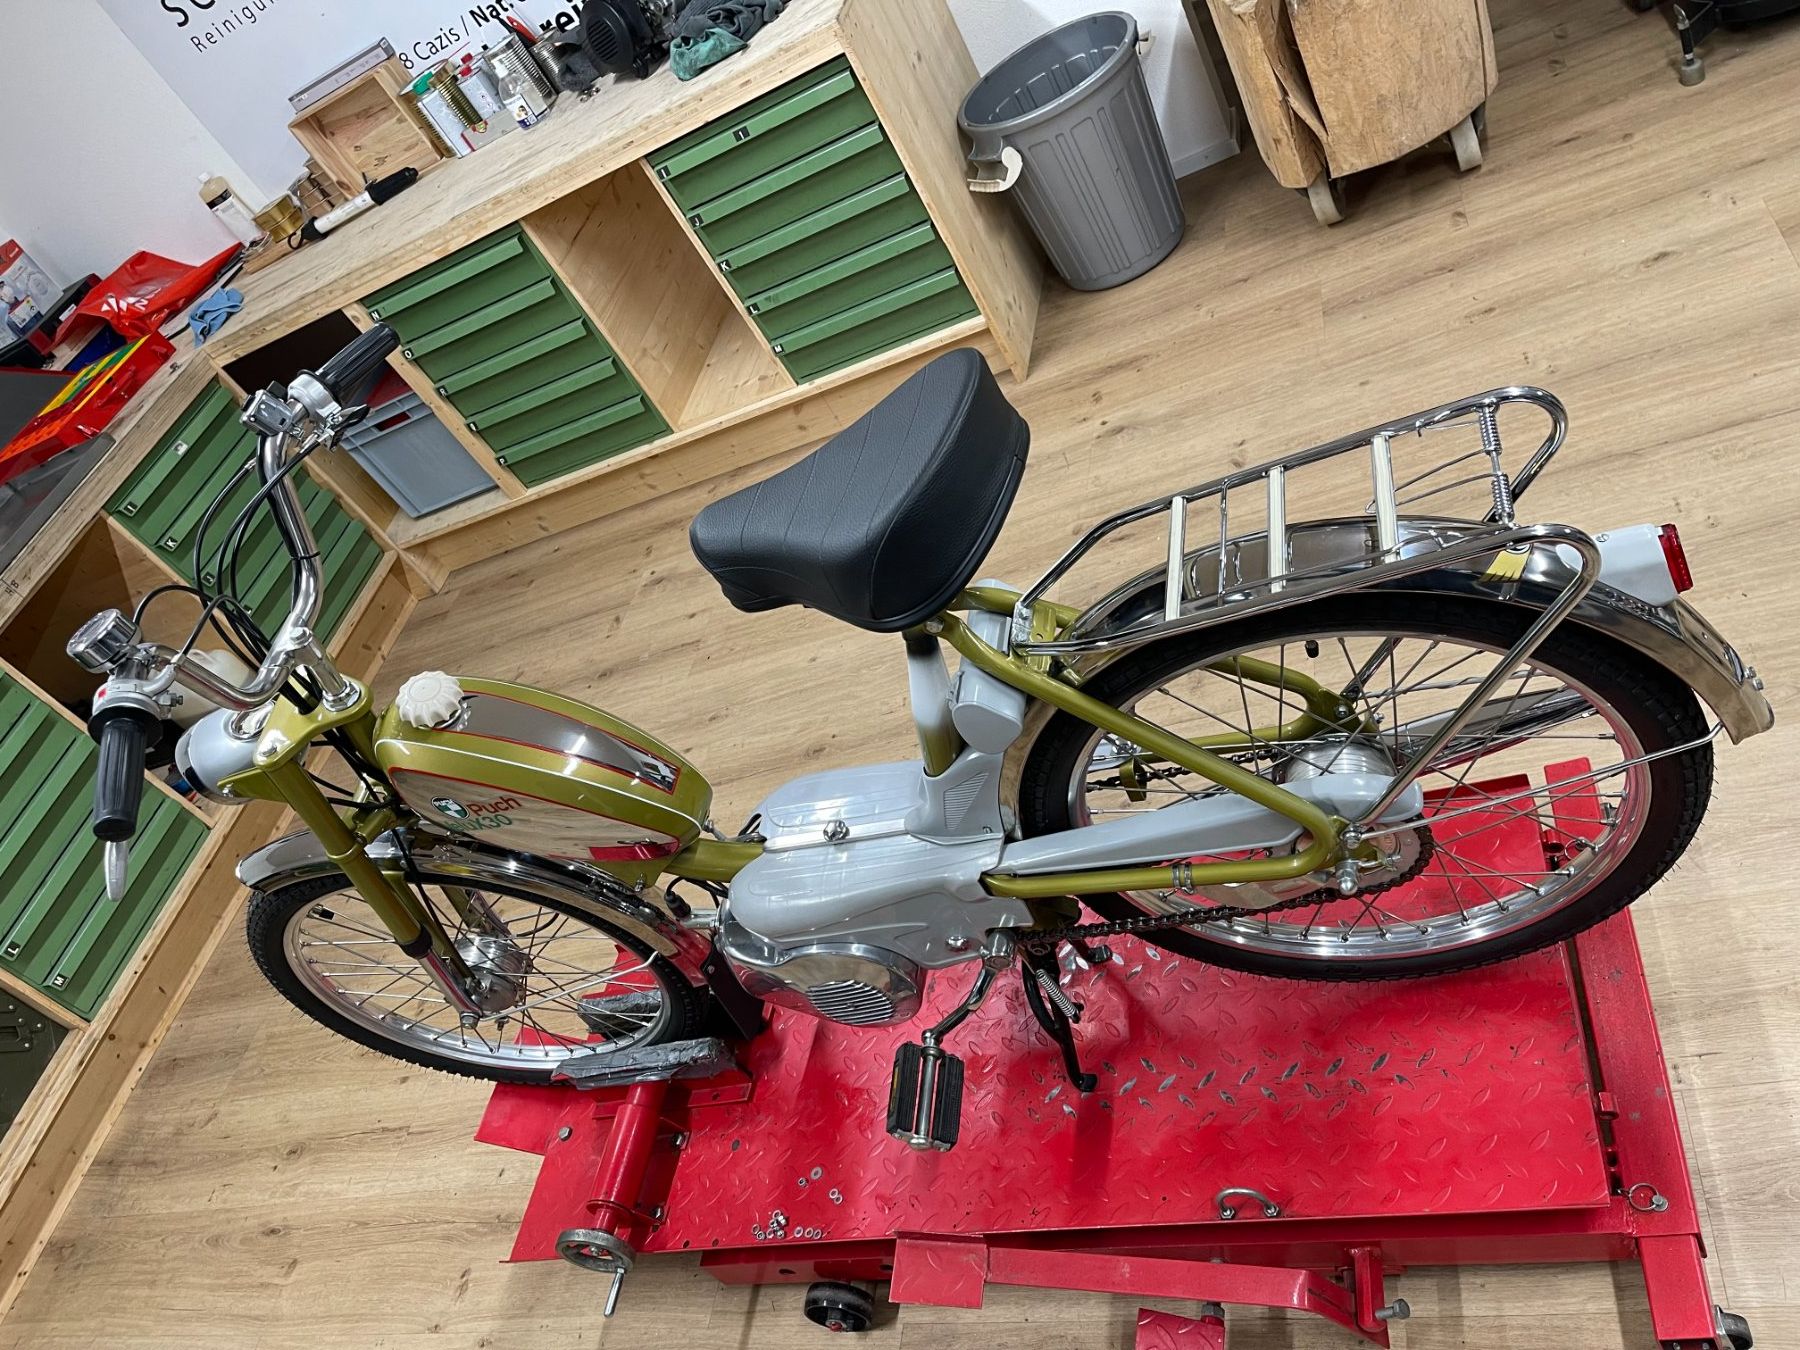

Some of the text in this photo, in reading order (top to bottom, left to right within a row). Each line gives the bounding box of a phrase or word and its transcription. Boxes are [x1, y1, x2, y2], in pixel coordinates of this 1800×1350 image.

[190, 0, 279, 53] Reinigu
[413, 27, 461, 60] Cazis
[720, 261, 730, 272] K
[749, 305, 758, 314] L
[466, 796, 522, 817] Puch
